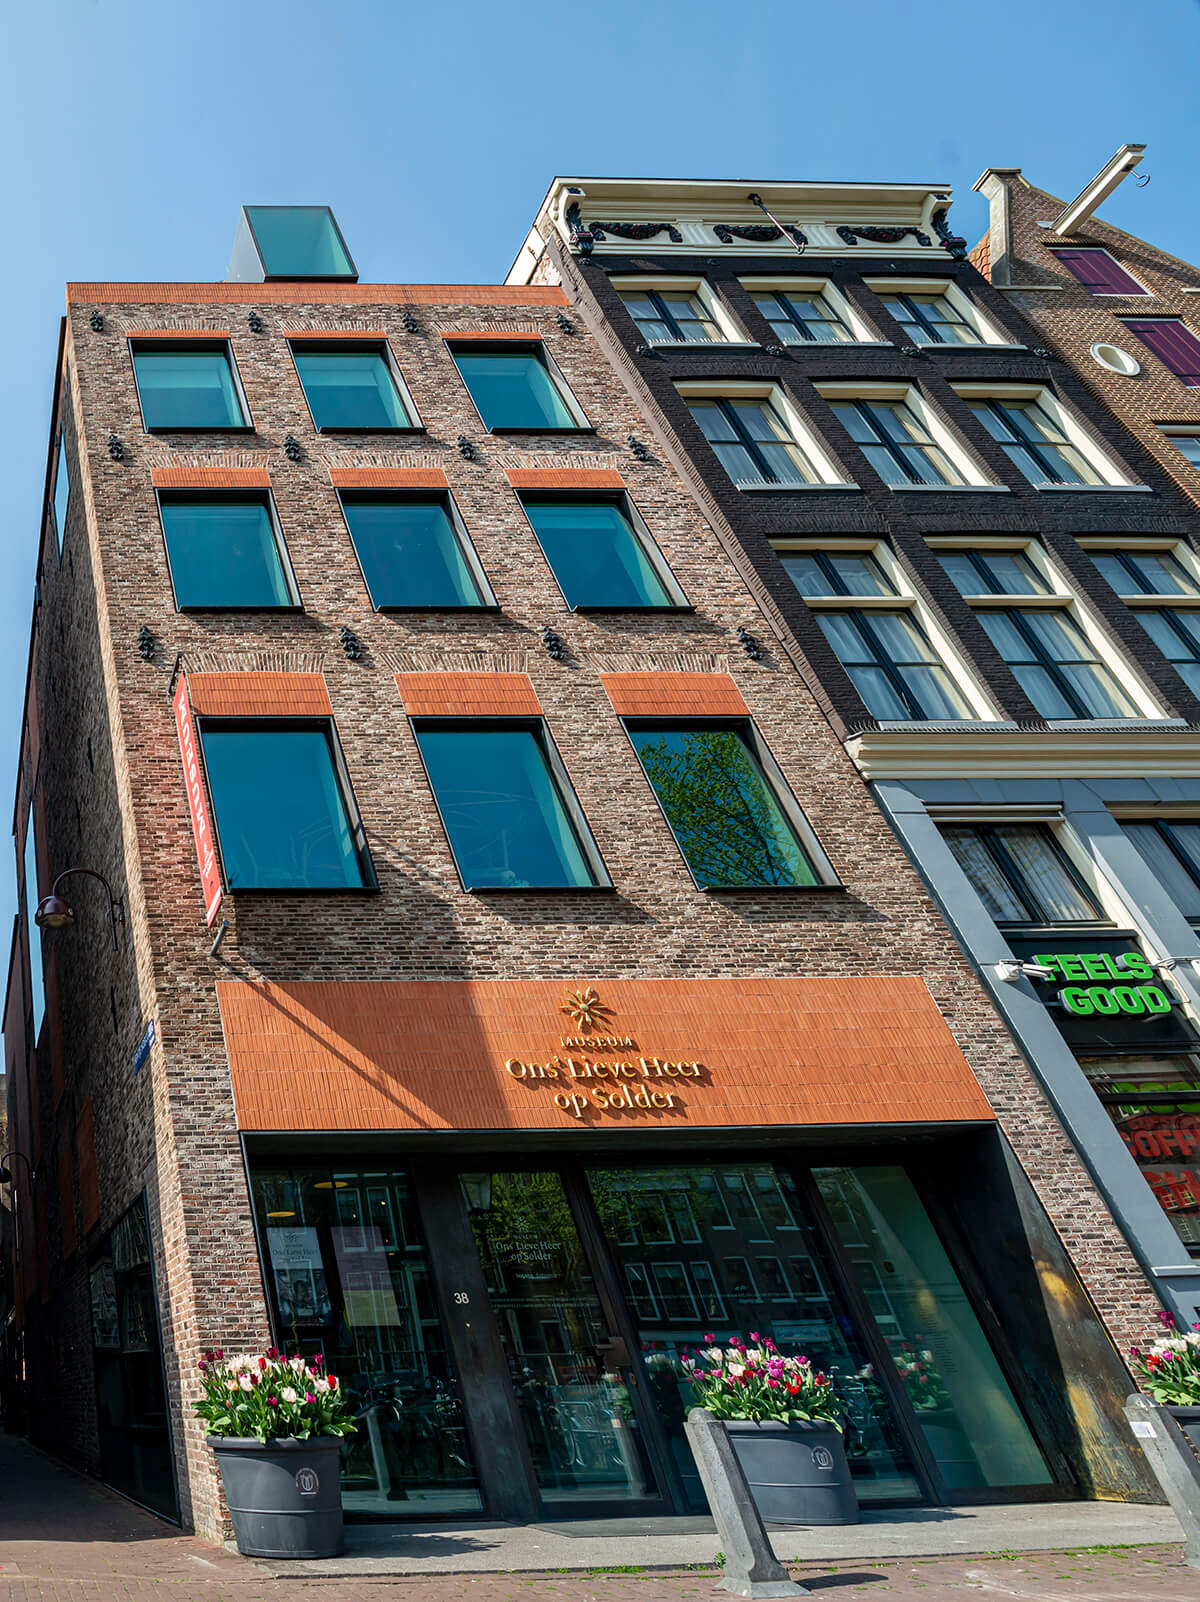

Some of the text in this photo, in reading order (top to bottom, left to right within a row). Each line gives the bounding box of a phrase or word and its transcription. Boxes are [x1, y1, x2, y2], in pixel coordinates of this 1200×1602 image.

[1031, 952, 1154, 982] FEELS
[1057, 985, 1172, 1015] GOOD
[560, 1036, 633, 1048] MUSEUM
[564, 1055, 637, 1078] Lieve
[636, 1056, 702, 1078] Heer
[554, 1084, 677, 1119] op Solder
[1118, 1129, 1200, 1157] OFF
[453, 1292, 470, 1305] 38
